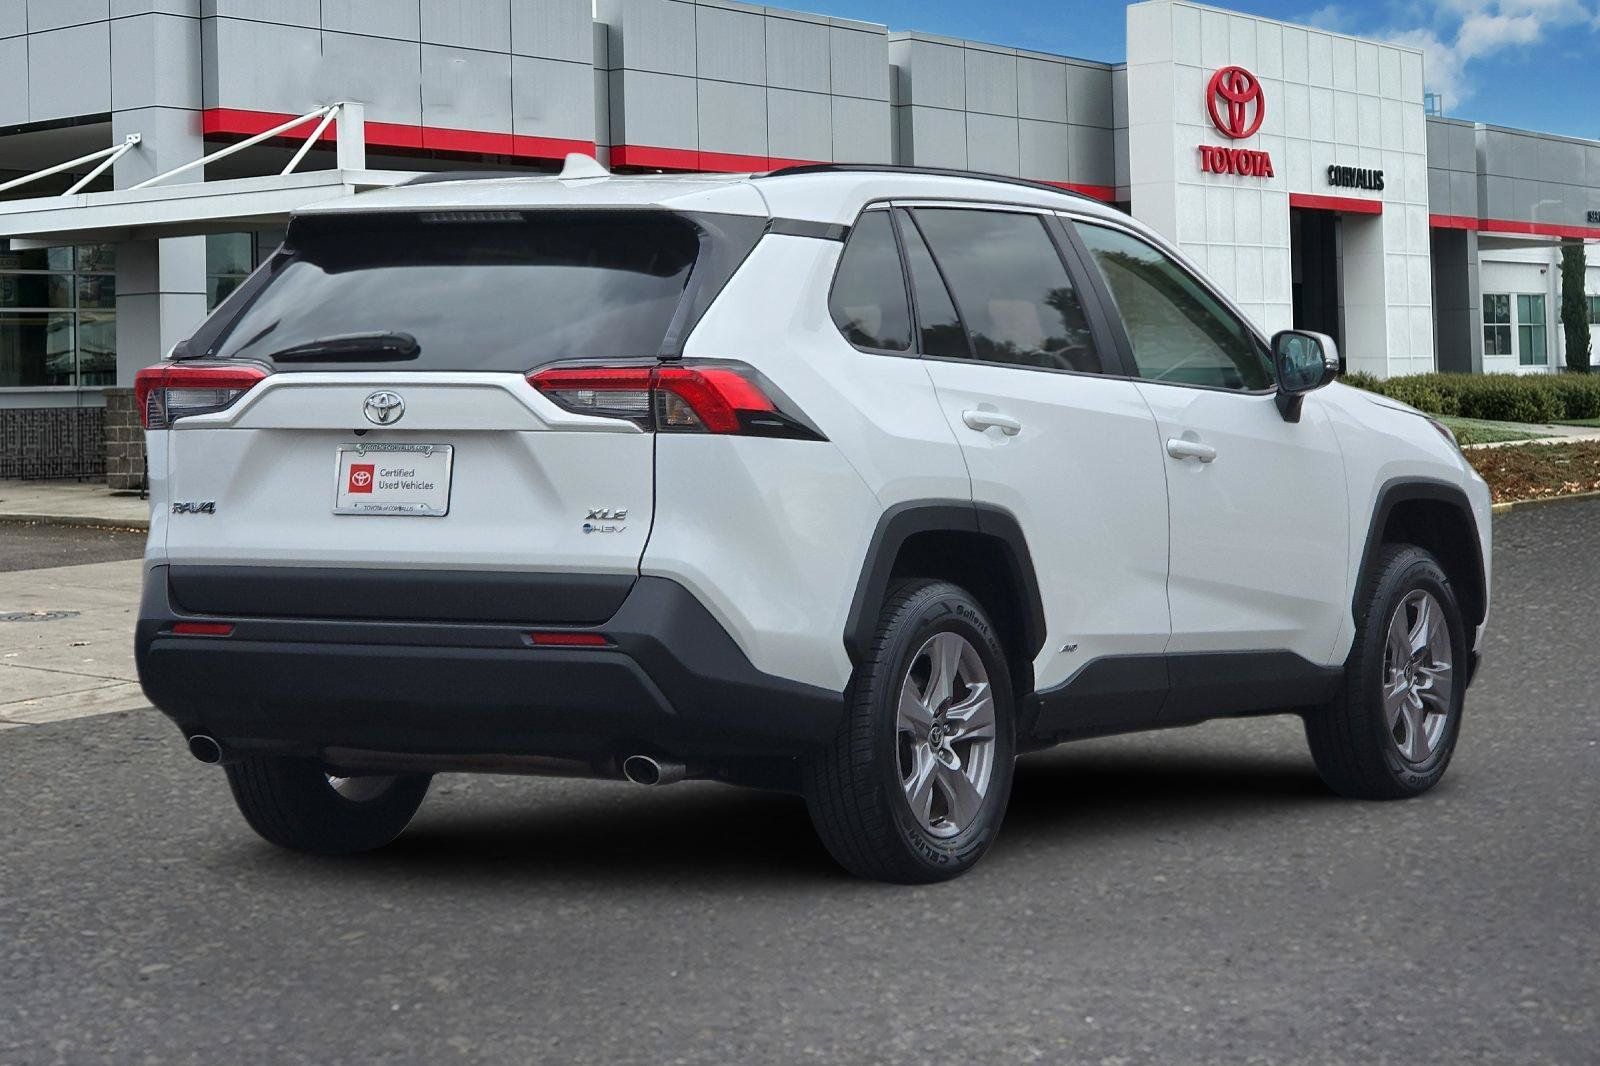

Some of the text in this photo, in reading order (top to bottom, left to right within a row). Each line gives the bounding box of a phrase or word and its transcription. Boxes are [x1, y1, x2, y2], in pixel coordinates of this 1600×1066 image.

[1199, 145, 1274, 178] TOYOTA
[1327, 164, 1385, 190] CORVALLIS
[380, 468, 415, 477] Certified
[379, 480, 434, 490] Used Vehicles
[171, 500, 216, 515] RAV4
[585, 508, 628, 521] XLE
[592, 525, 626, 533] HEV
